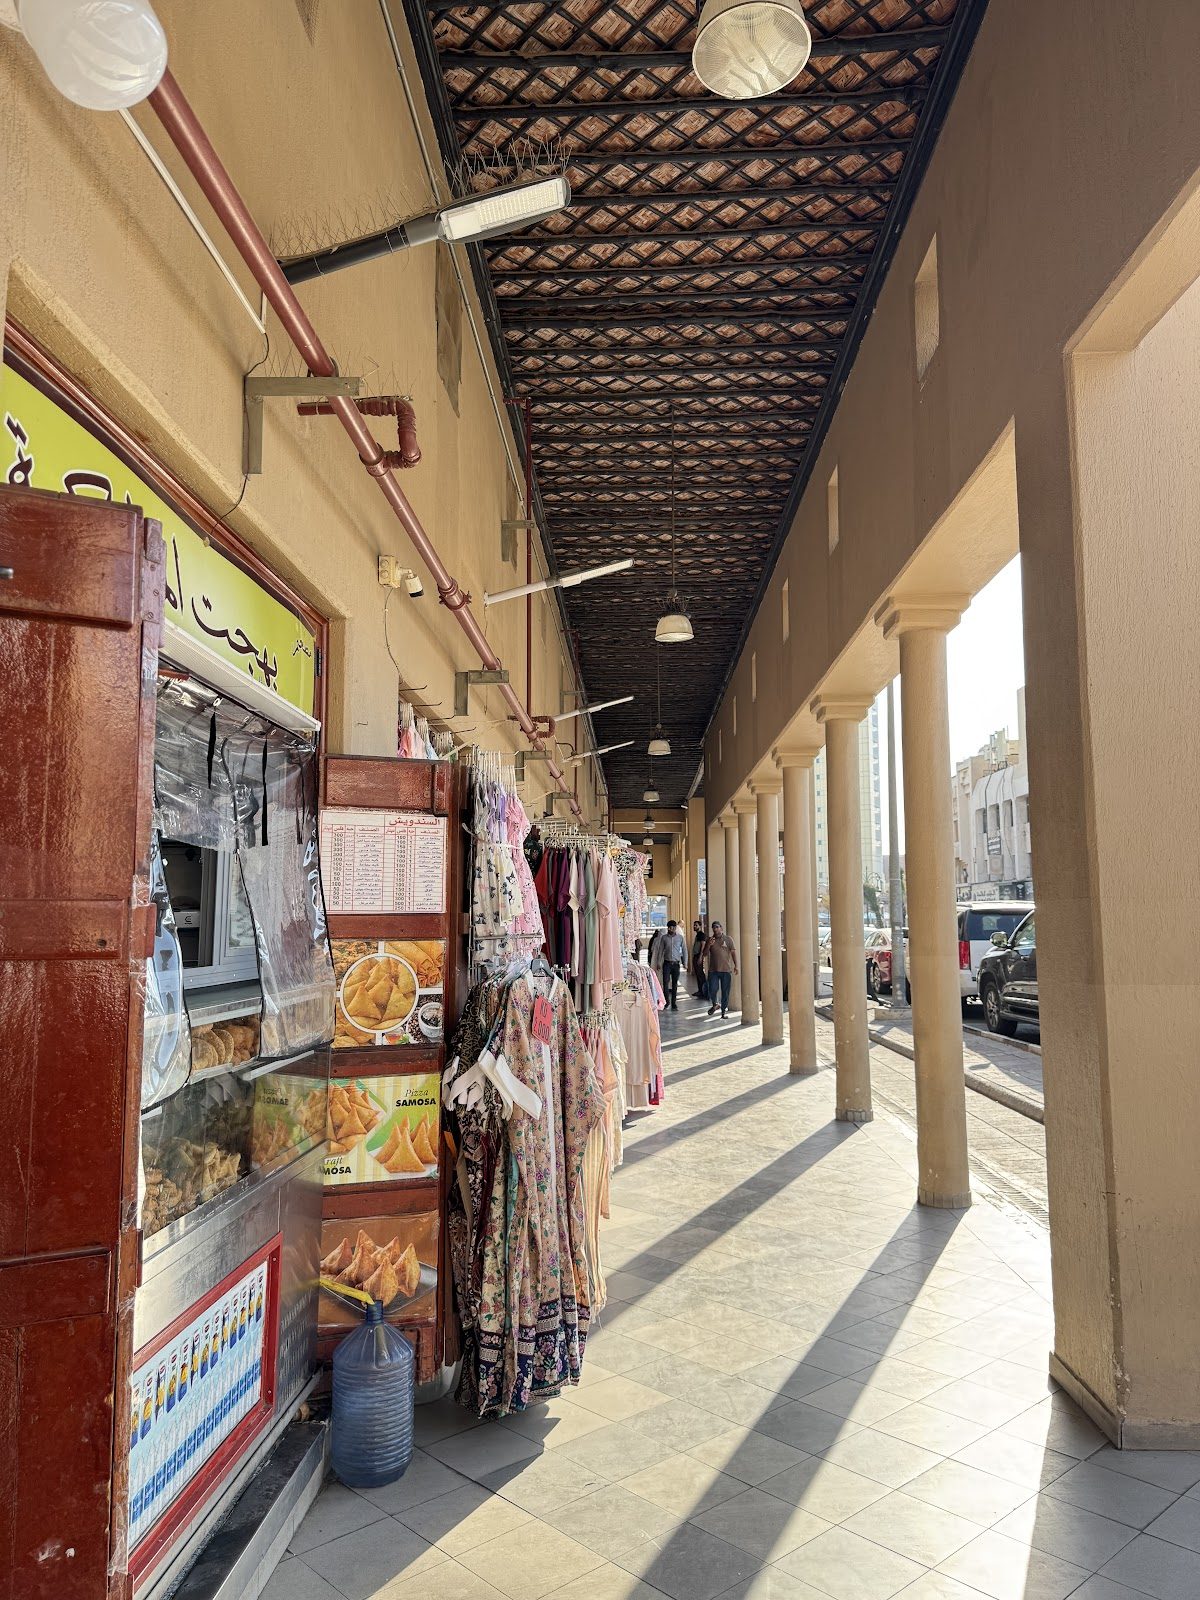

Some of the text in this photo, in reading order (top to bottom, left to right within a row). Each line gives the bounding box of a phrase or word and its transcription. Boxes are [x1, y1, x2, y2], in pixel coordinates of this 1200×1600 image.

[389, 816, 440, 826] السندويش
[405, 1088, 429, 1097] Pizza
[395, 1098, 437, 1107] SAMOSA
